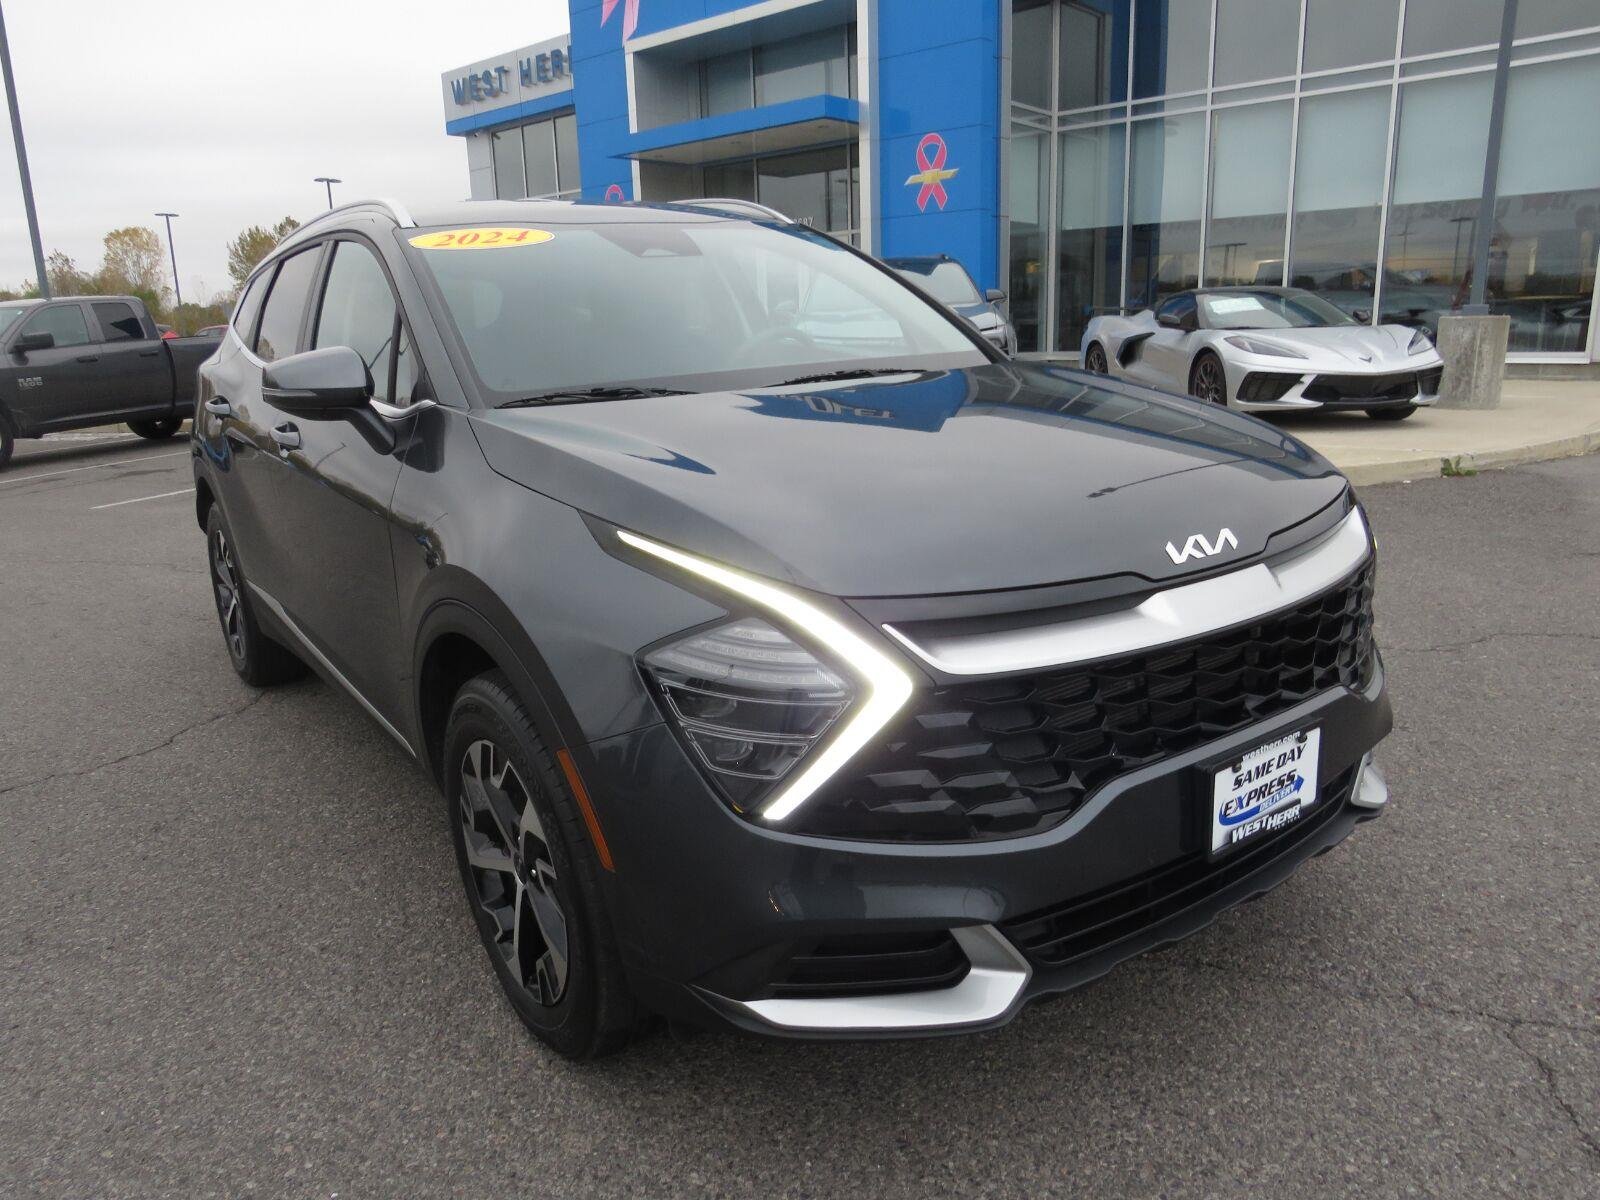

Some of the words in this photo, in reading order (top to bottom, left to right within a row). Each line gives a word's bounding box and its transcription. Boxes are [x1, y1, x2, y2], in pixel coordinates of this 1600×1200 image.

[450, 65, 509, 105] WEST
[432, 230, 530, 246] 2024
[1165, 528, 1238, 565] KIA
[1233, 757, 1275, 790] SAME
[1276, 743, 1307, 770] DAY
[1224, 769, 1297, 816] EXPRESS
